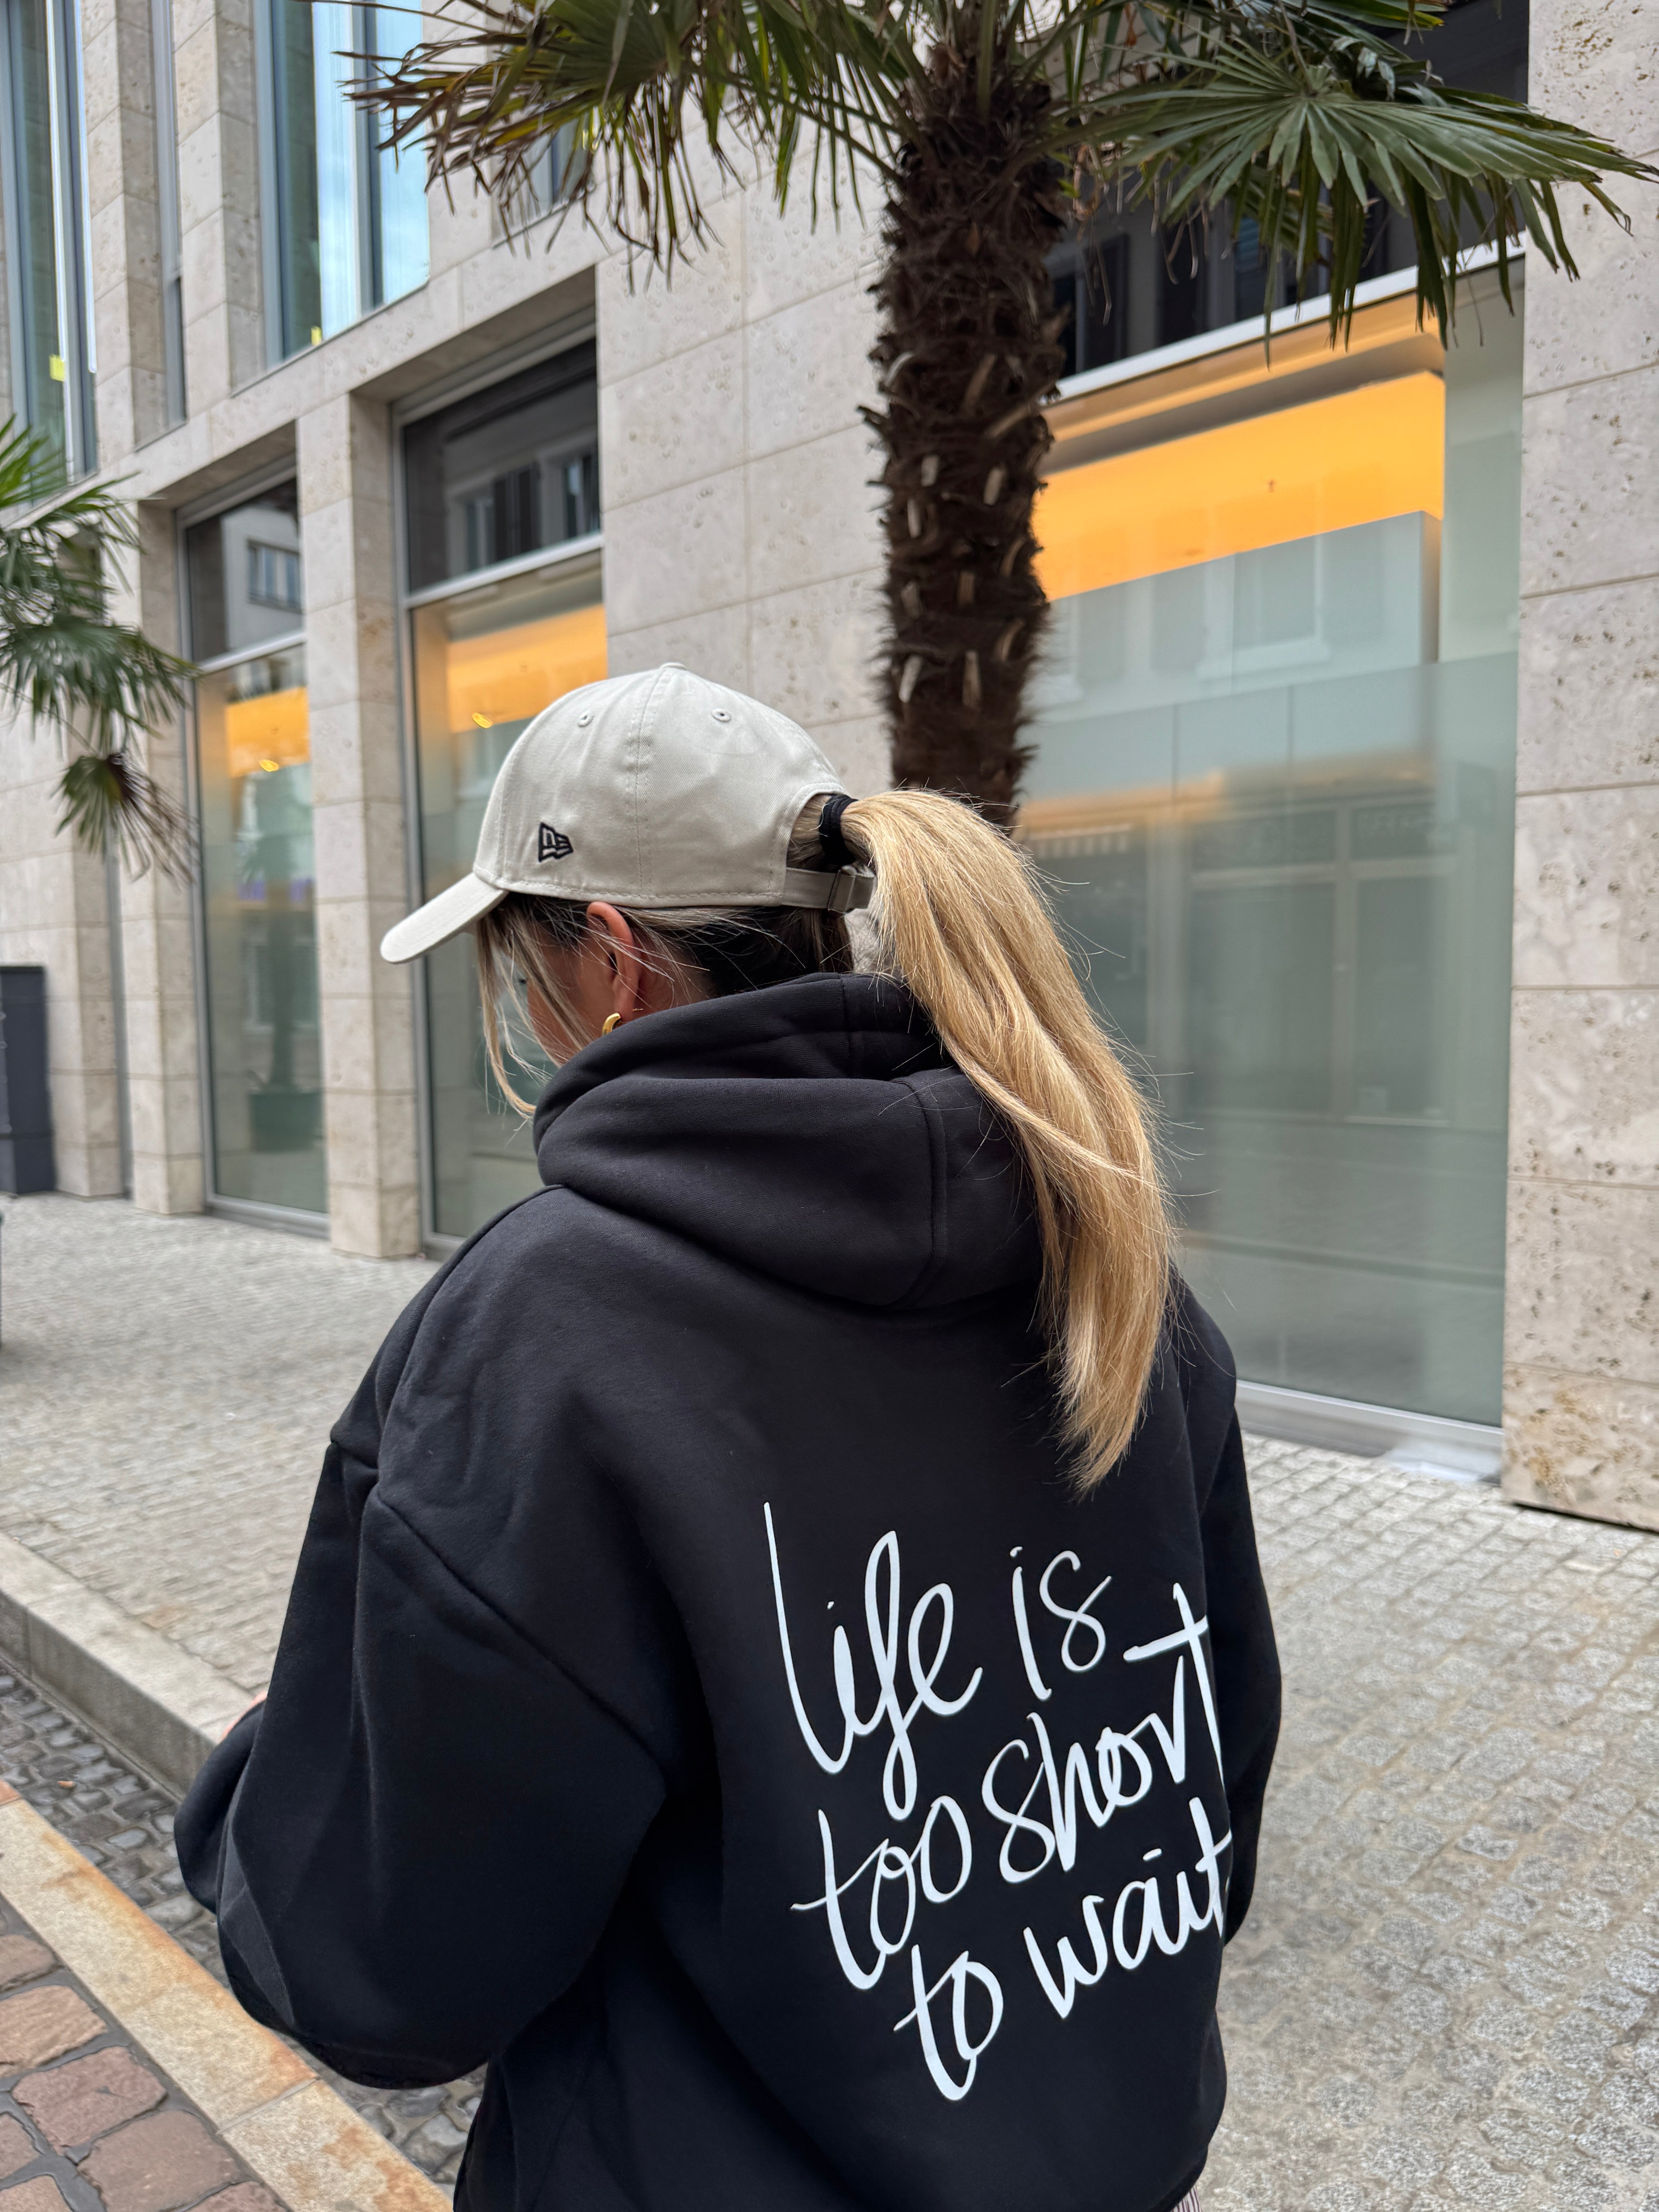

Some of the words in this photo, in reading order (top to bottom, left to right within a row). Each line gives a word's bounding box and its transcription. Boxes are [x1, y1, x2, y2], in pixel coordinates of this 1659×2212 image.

[1010, 1546, 1112, 1700] is
[790, 1795, 972, 1990] too
[981, 1582, 1226, 1884] short
[893, 1944, 1004, 2101] to
[1023, 1796, 1233, 2019] wait
